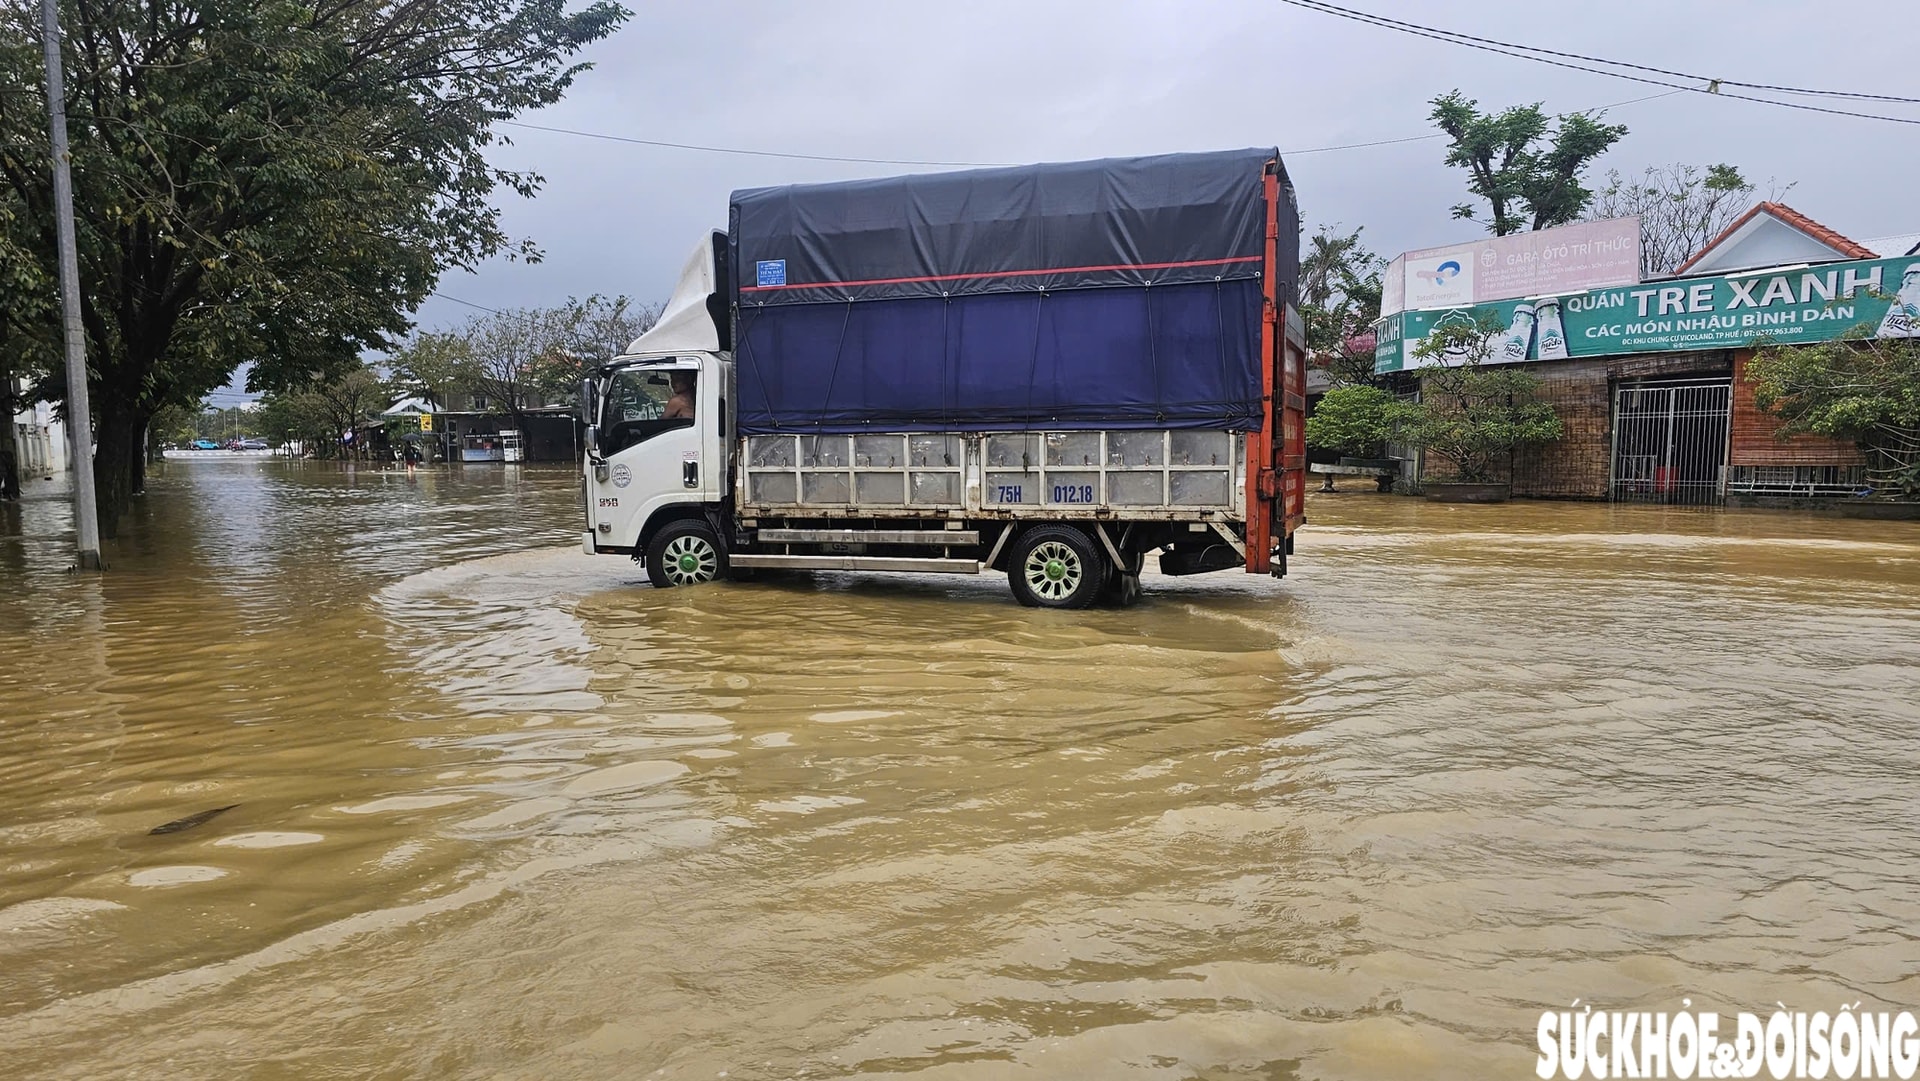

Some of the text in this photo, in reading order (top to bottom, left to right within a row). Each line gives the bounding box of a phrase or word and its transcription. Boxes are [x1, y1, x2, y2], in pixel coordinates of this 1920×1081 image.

[1506, 235, 1632, 266] GARA ÔTÔ TRÍ THỨC
[1567, 266, 1883, 317] QUÁN TRE XANH
[1585, 324, 1621, 338] CÁC
[1625, 319, 1671, 335] MÓN
[1676, 315, 1736, 332] NHẬU
[1741, 309, 1796, 327] BÌNH
[1634, 336, 1647, 345] KHU
[1647, 335, 1670, 344] CHUNG
[1680, 332, 1715, 342] VICOLAND,
[998, 485, 1093, 503] 75H 012.18
